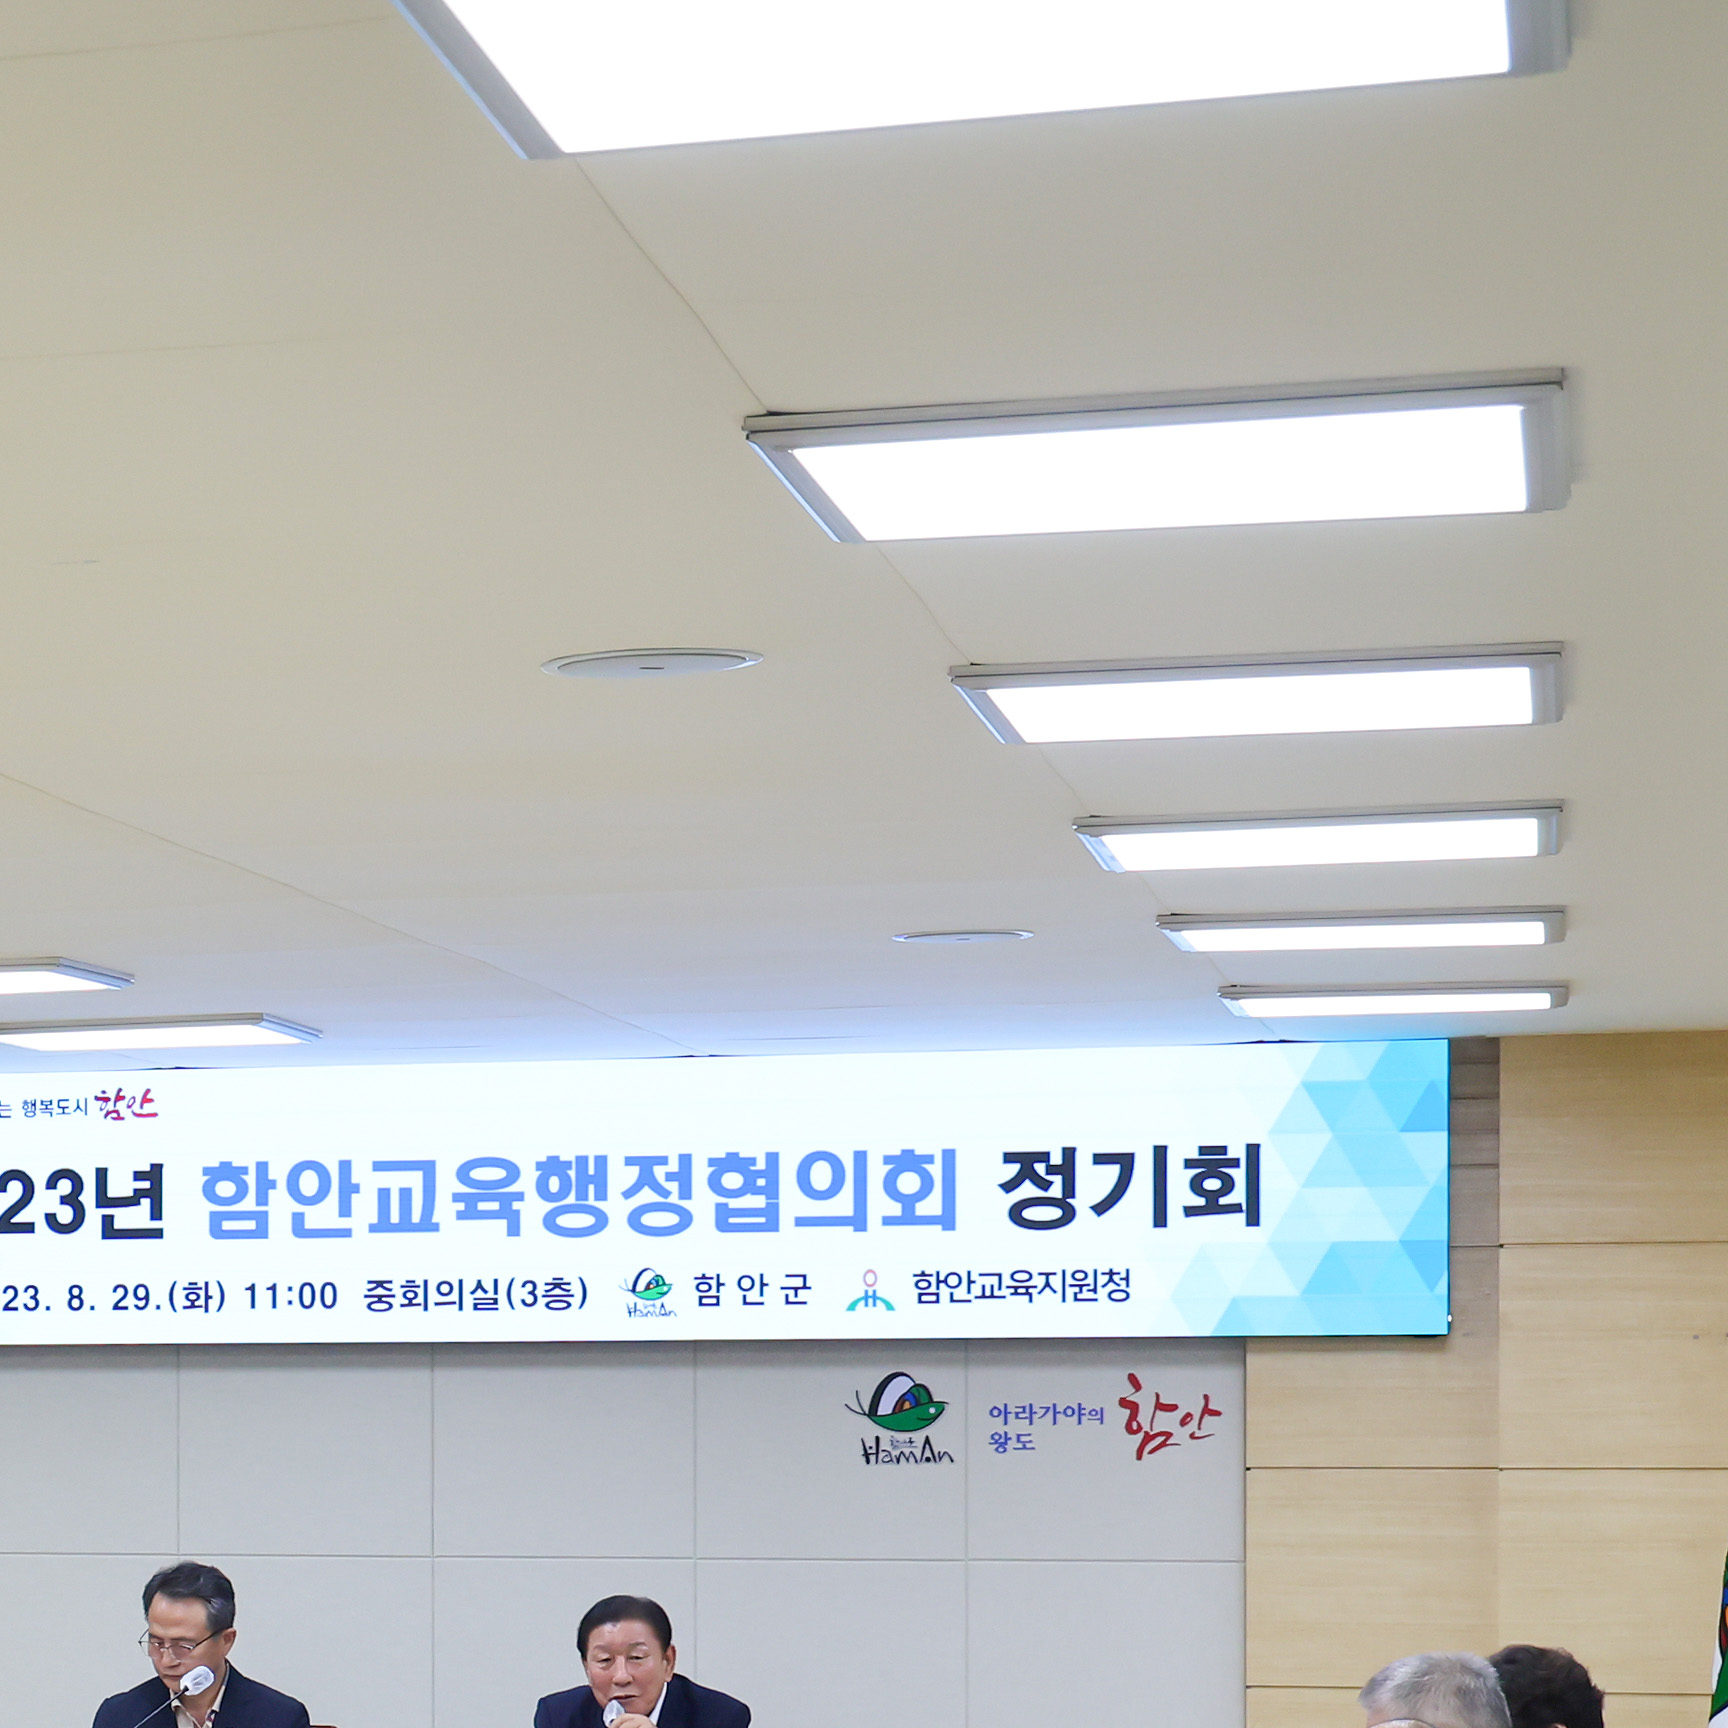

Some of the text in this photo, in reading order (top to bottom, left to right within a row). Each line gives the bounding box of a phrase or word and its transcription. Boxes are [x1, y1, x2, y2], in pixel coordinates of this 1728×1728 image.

[21, 1097, 89, 1118] 행복도시
[93, 1087, 159, 1122] 함안
[200, 1147, 958, 1240] 함안교육행정협의회
[996, 1142, 1263, 1232] 정기회
[66, 1284, 97, 1312] 8.
[243, 1281, 339, 1311] 11:00
[363, 1275, 588, 1314] 중회의실(3층)
[912, 1267, 1132, 1305] 함안교육지원청
[988, 1402, 1105, 1426] 아라가야의
[1118, 1372, 1223, 1462] 함안
[860, 1434, 955, 1465] HamAn
[988, 1431, 1037, 1454] 왕도
